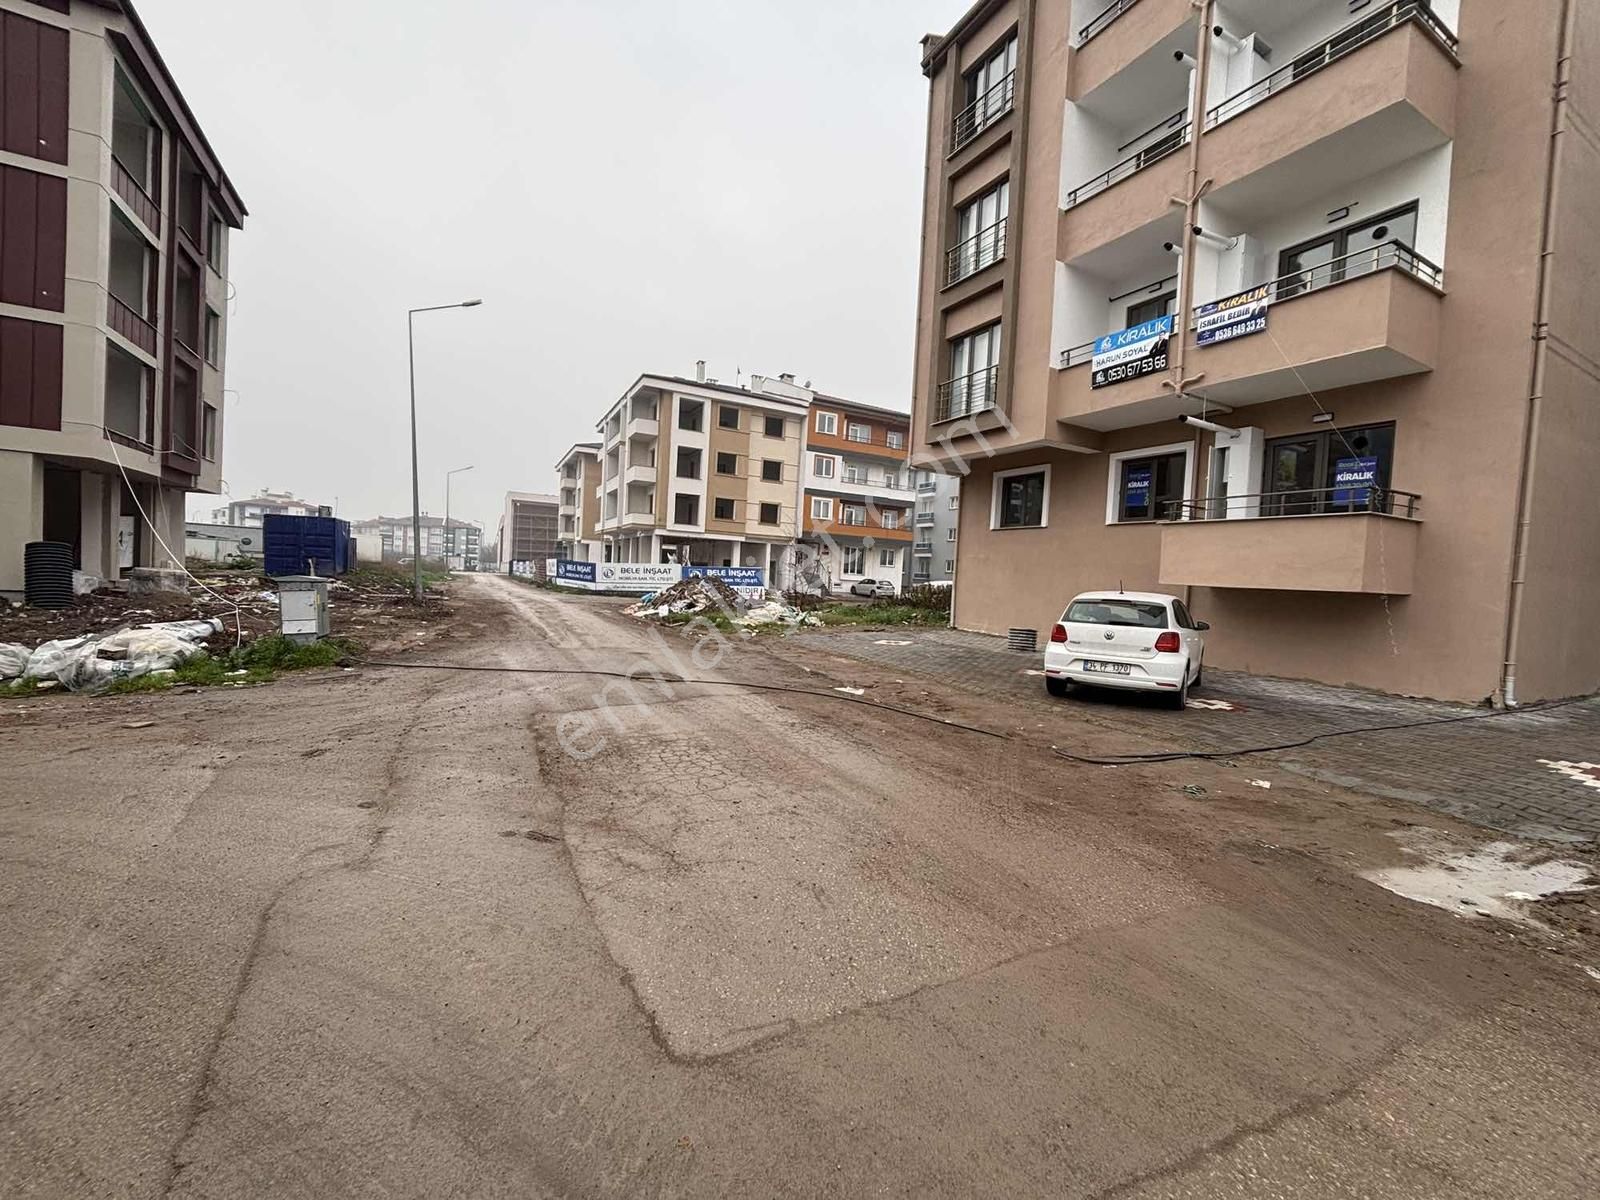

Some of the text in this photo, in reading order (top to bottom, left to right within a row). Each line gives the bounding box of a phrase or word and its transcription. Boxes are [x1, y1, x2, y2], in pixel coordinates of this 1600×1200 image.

[1218, 286, 1268, 311] KİRALIK
[1117, 318, 1169, 345] KİRALIK
[1215, 327, 1232, 341] 0536
[1233, 323, 1246, 336] 649
[1247, 320, 1255, 332] 33
[1256, 317, 1266, 329] 25
[1096, 345, 1148, 367] HARUN SOYAL
[1108, 354, 1166, 381] 0530 677 53 66
[1127, 480, 1150, 488] KİRALIK
[1336, 471, 1374, 482] KİRALIK
[643, 566, 673, 576] İNŞAAT
[728, 568, 756, 577] İNŞAAT
